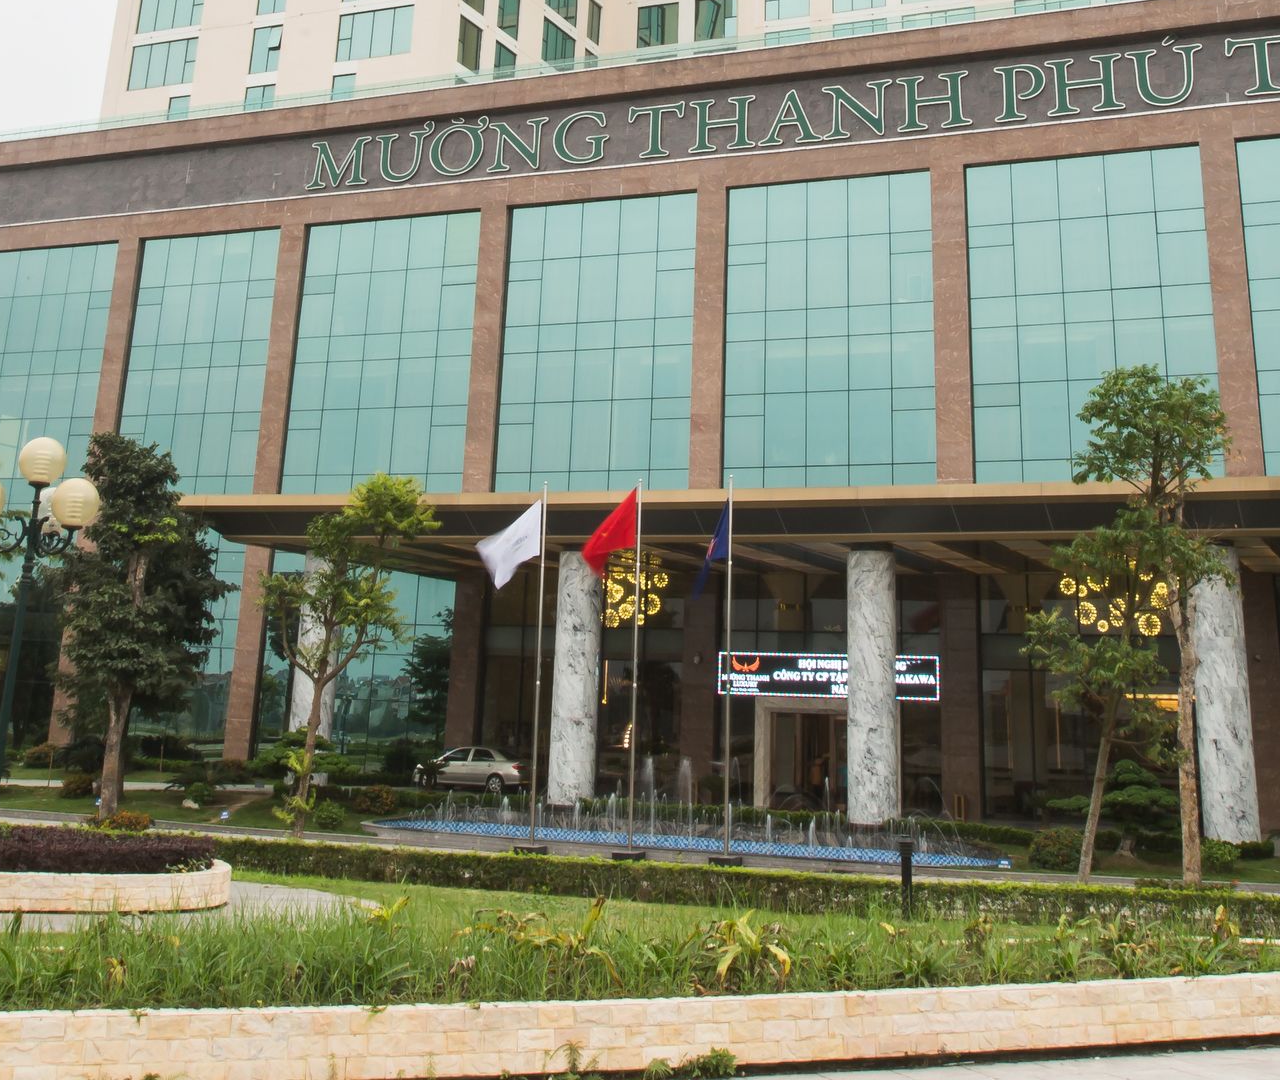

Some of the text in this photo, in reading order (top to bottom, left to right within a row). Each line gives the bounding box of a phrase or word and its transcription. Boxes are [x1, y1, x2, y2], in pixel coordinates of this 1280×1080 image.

[305, 111, 610, 190] MƯỜNG
[627, 70, 973, 159] THANH
[993, 35, 1202, 123] PHÚ
[773, 668, 801, 681] CÔNG
[801, 671, 815, 681] TY
